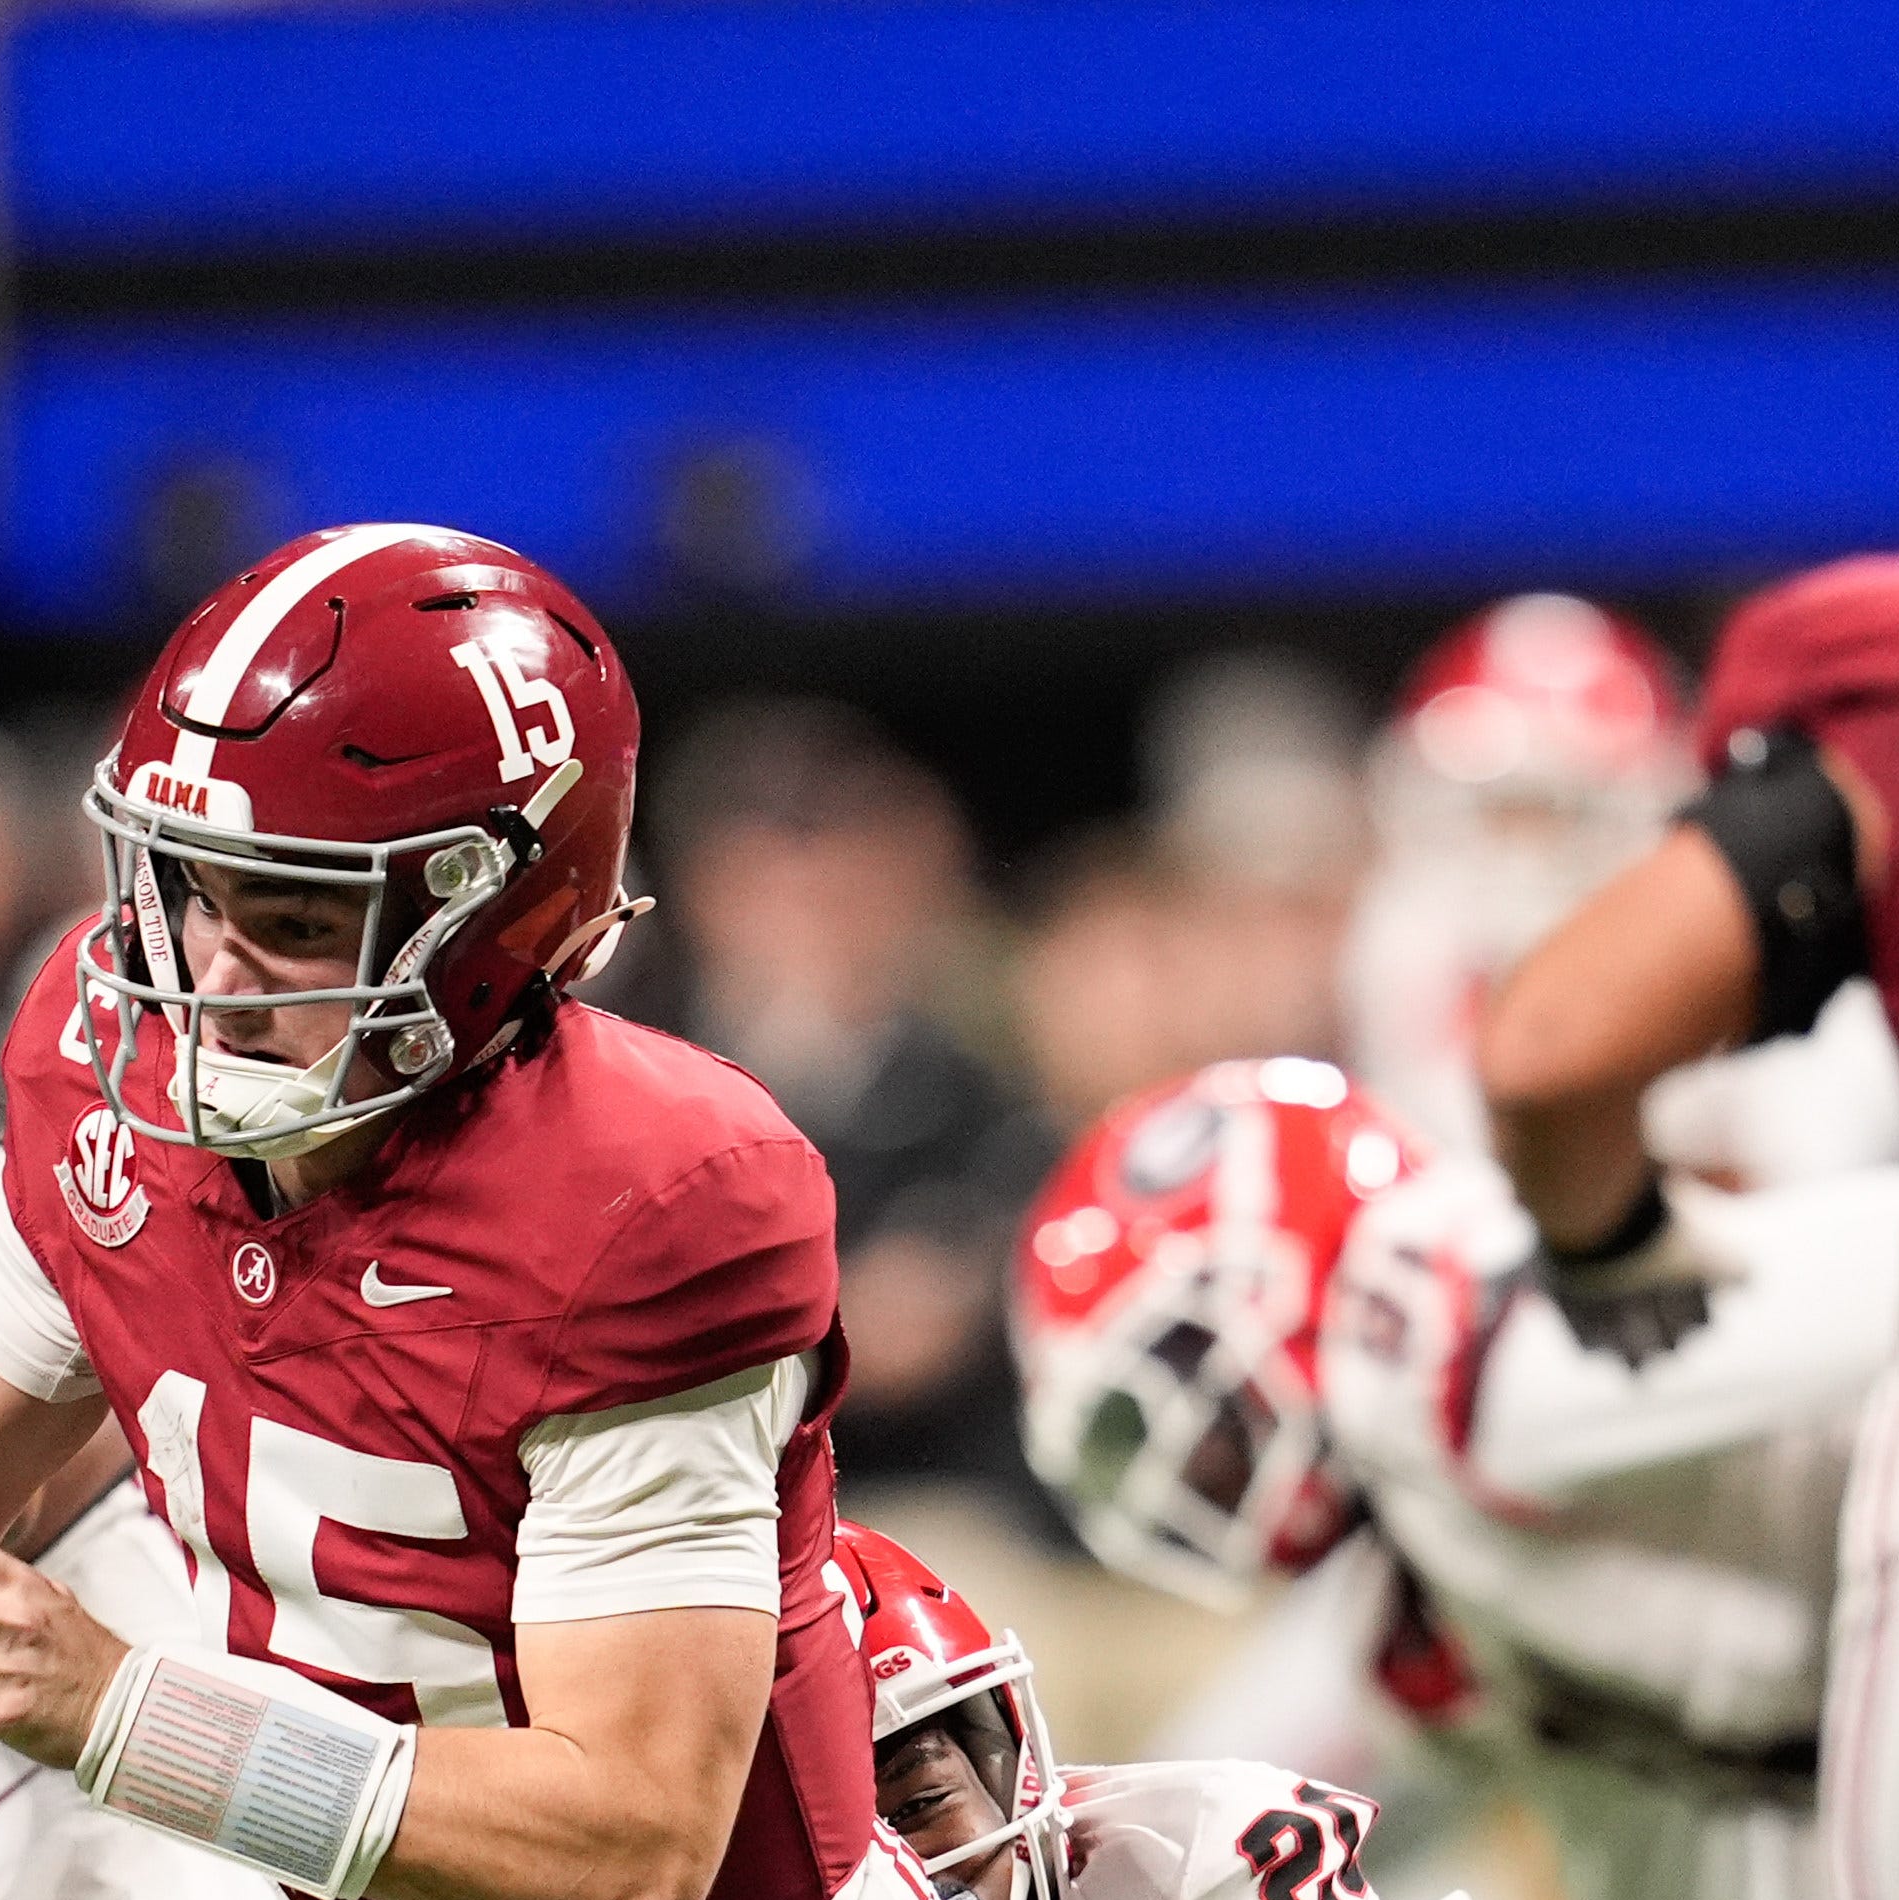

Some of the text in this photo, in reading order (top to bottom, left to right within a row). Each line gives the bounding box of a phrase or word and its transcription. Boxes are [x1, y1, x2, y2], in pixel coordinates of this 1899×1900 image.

[449, 634, 576, 784] 15
[146, 772, 209, 818] BAMA
[144, 916, 169, 964] TIDE
[75, 1108, 136, 1209] SEC
[67, 1187, 134, 1244] GRADUATE
[238, 1252, 268, 1291] A
[137, 1369, 509, 1728] 15
[875, 1652, 913, 1681] GS
